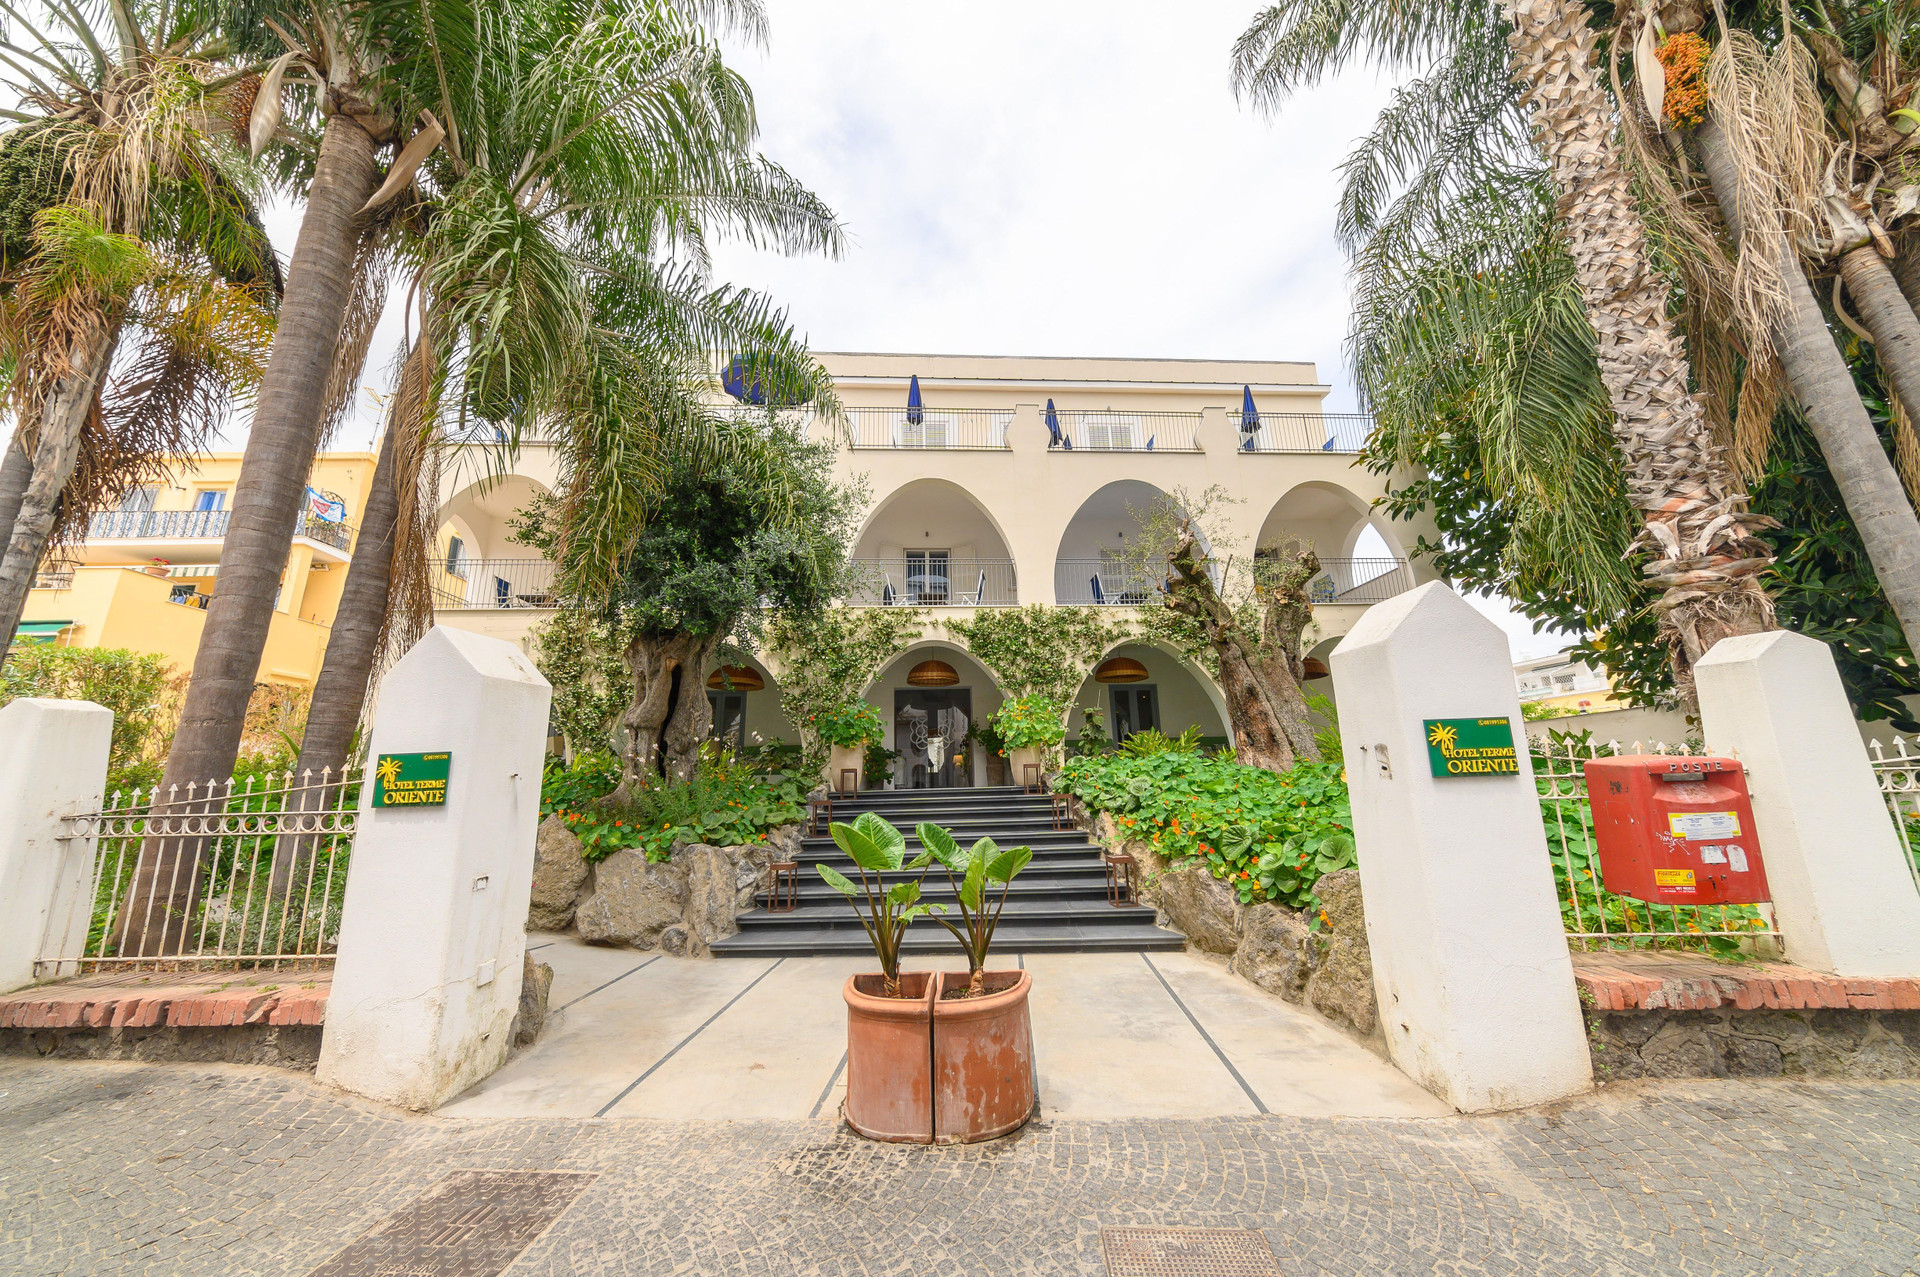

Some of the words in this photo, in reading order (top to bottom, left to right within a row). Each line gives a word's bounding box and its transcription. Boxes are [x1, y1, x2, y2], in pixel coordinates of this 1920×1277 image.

[1445, 748, 1480, 758] HOTEL
[1480, 747, 1516, 757] TERME
[1447, 758, 1519, 774] ORIENTE
[1669, 762, 1723, 772] POSTE
[385, 781, 415, 790] HOTEL
[416, 779, 446, 789] TERME
[383, 790, 445, 804] ORIENTE
